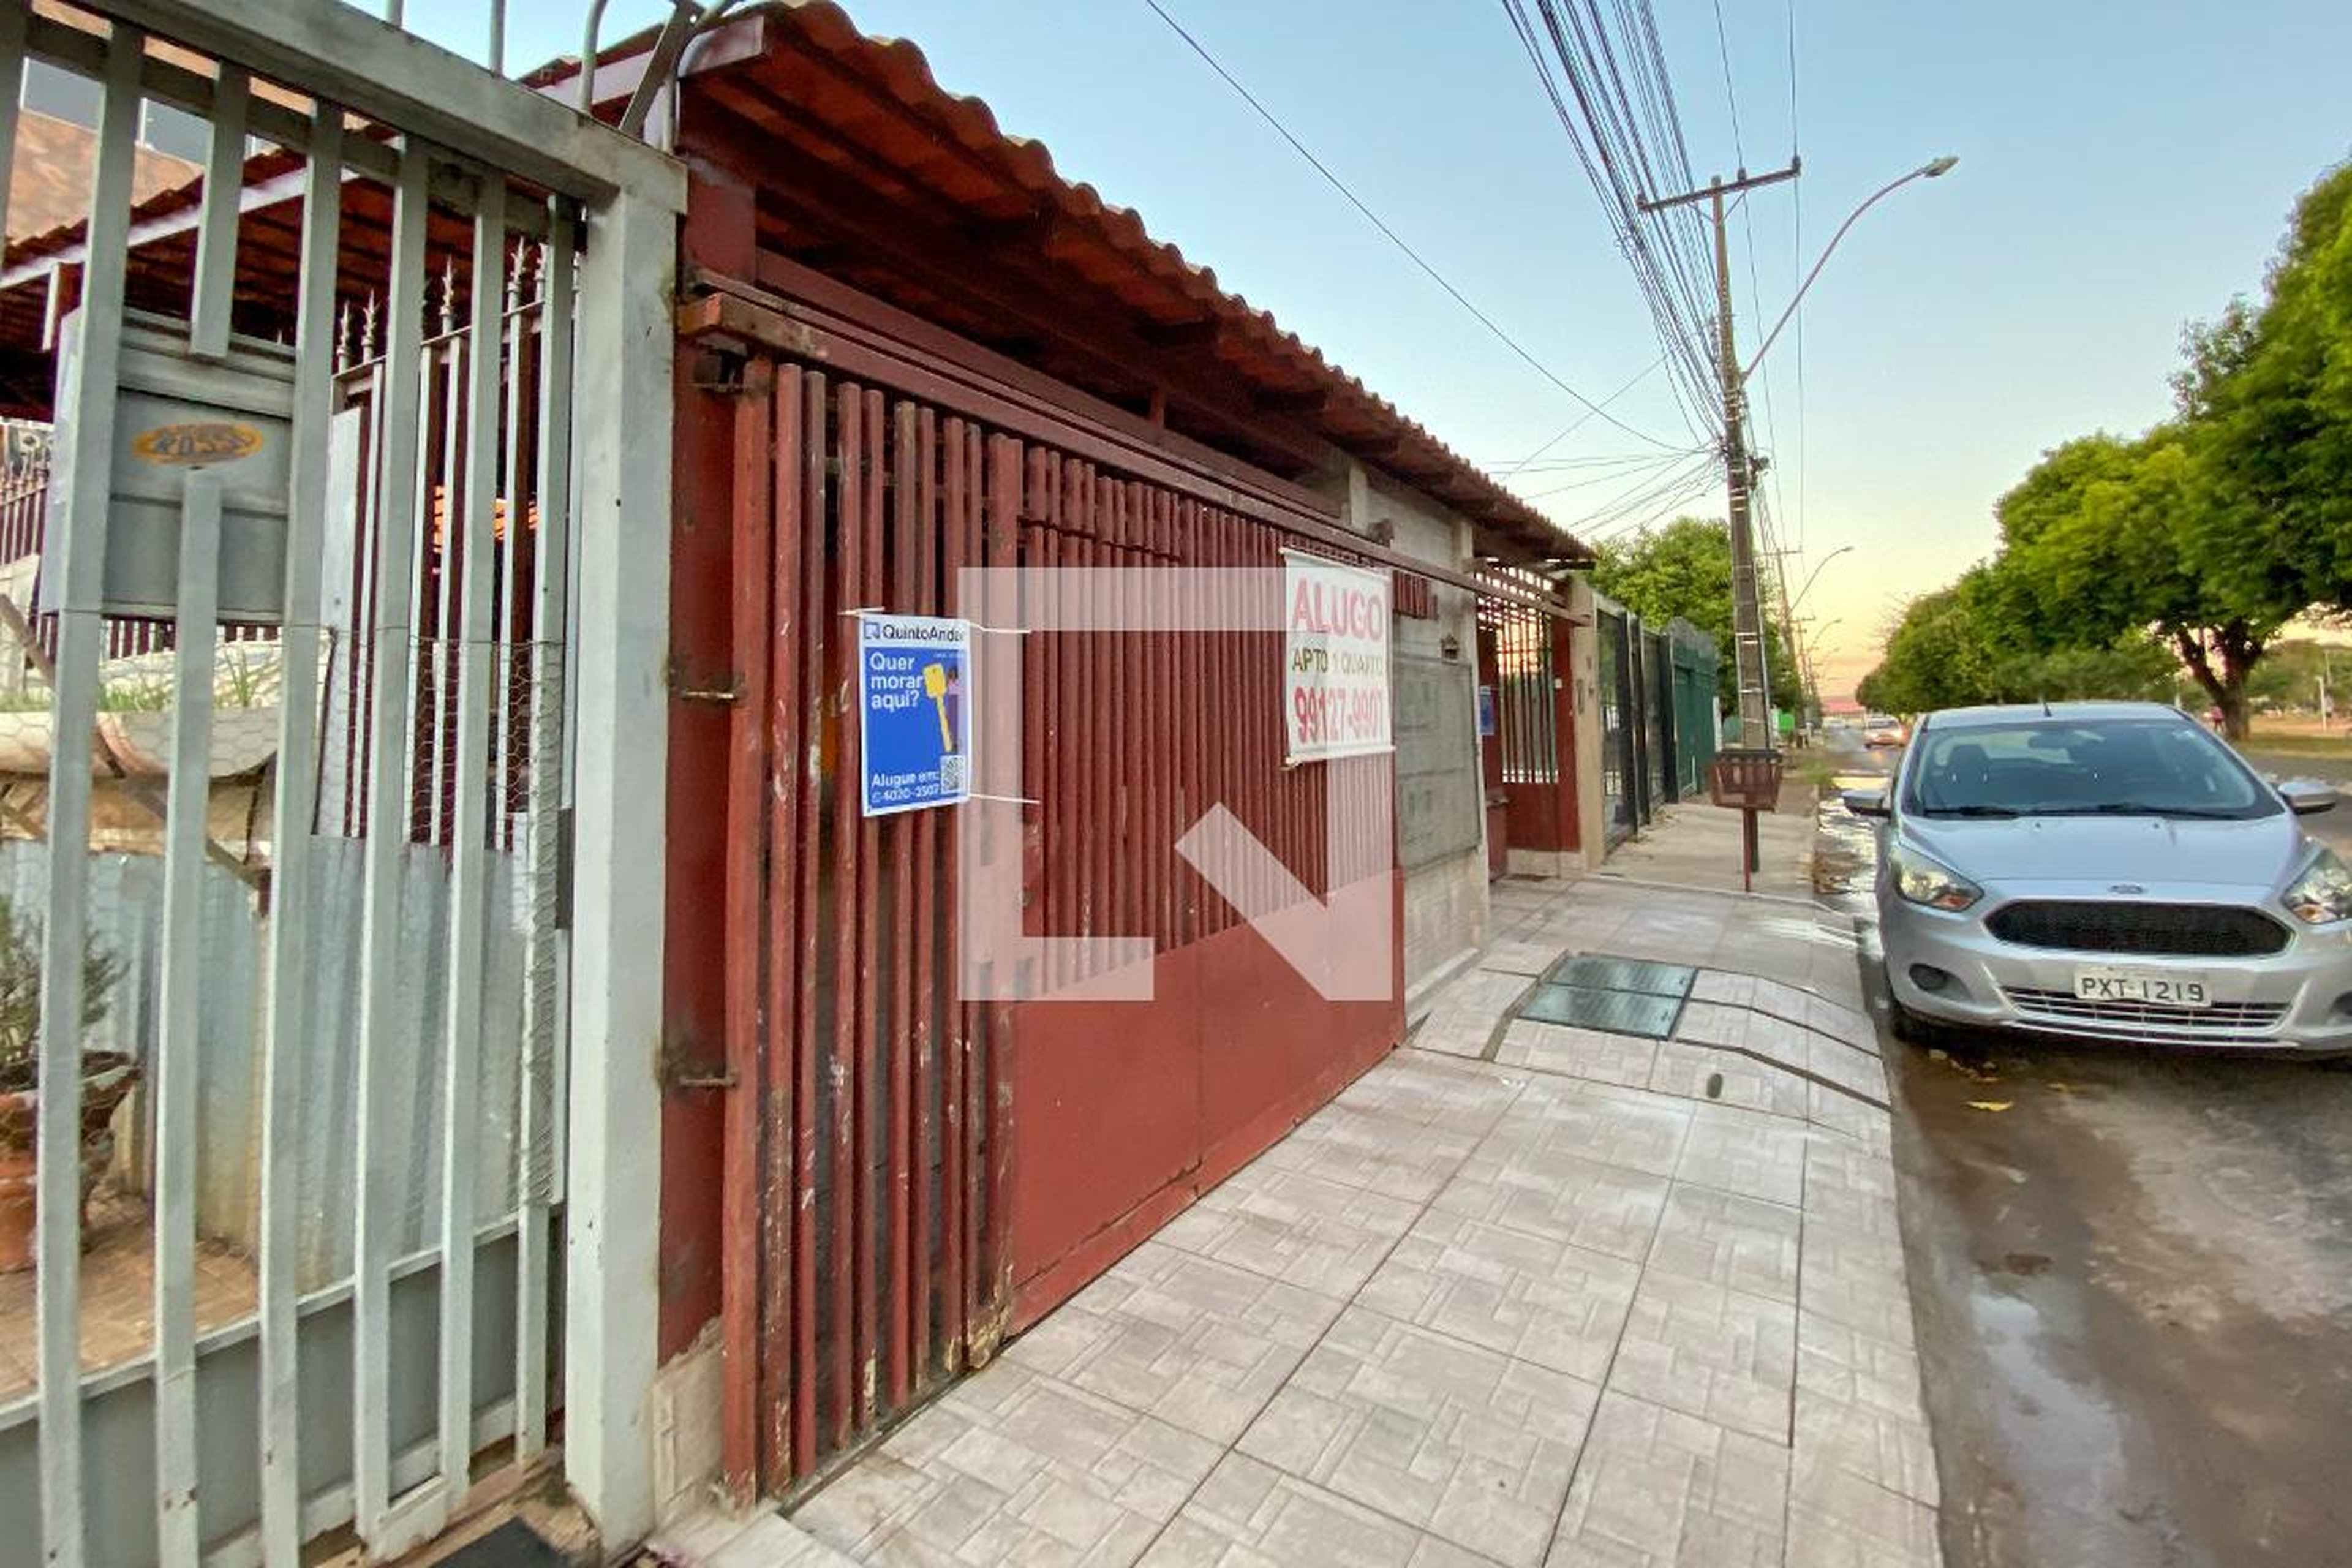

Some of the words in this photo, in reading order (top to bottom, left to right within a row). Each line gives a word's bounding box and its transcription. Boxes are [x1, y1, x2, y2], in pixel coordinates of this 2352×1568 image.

[1292, 578, 1383, 641] ALUGO
[870, 652, 915, 670] Quer
[1292, 648, 1328, 673] APTO
[870, 674, 924, 690] morar
[871, 690, 919, 712] aqui?
[872, 773, 916, 788] Alugue
